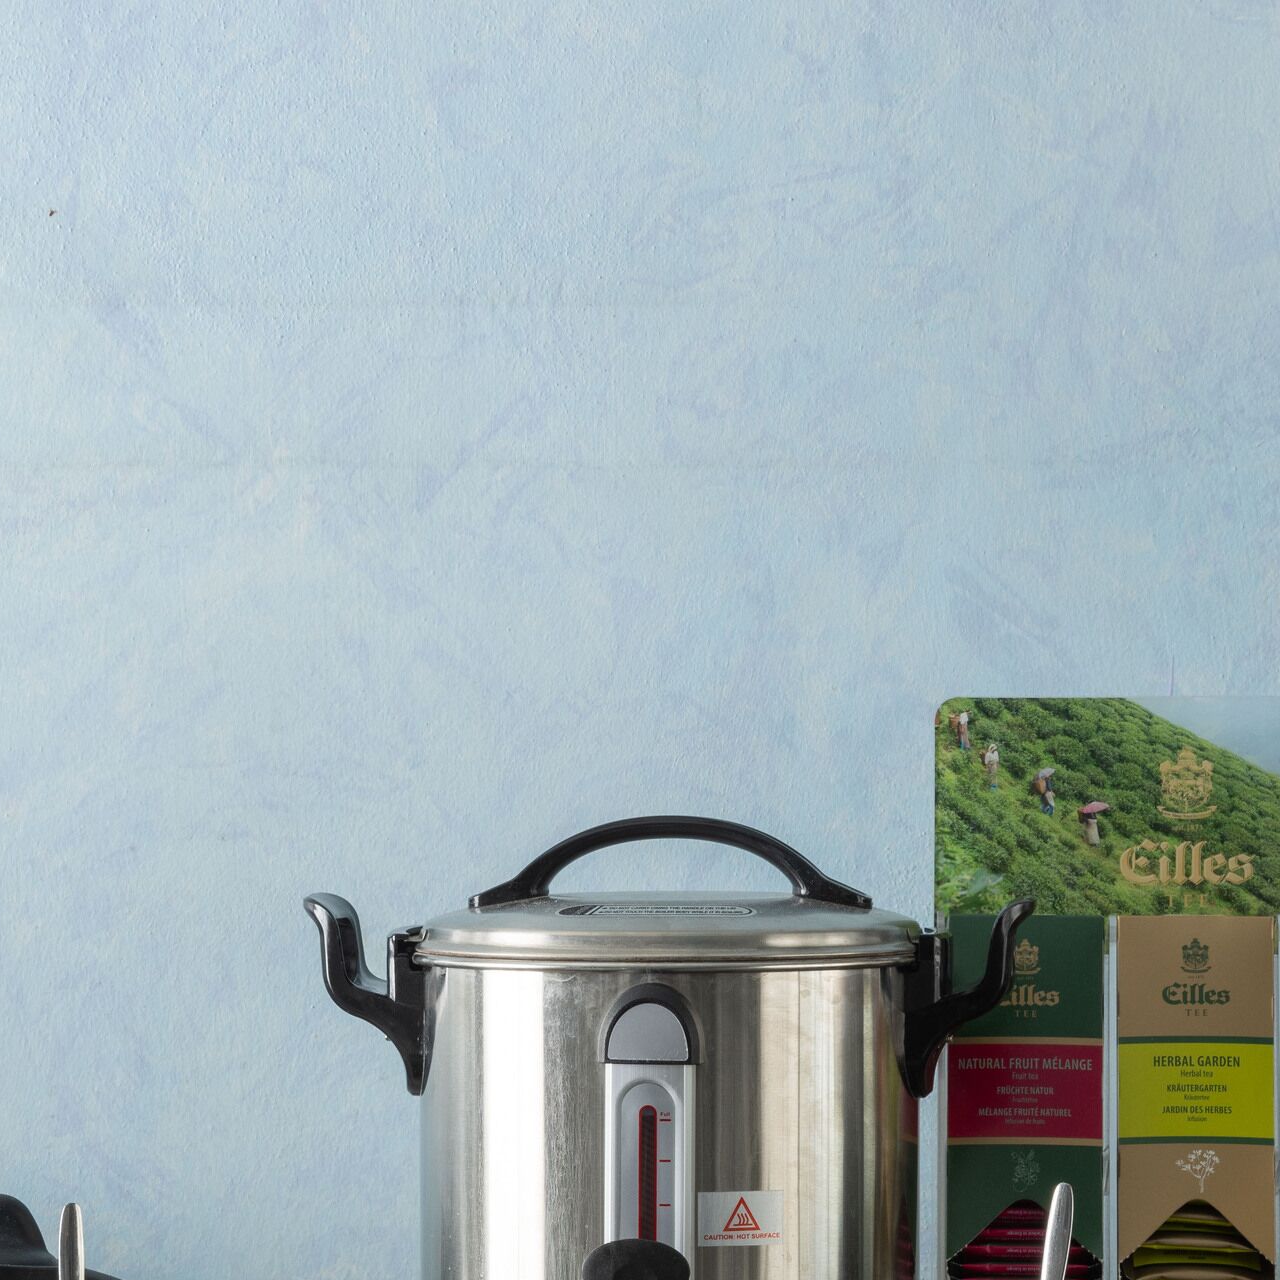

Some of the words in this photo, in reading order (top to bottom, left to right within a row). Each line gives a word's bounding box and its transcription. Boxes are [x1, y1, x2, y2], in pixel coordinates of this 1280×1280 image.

[1120, 838, 1256, 886] Eilles
[1000, 983, 1061, 1007] illes
[1161, 981, 1231, 1006] Eilles
[1015, 1009, 1038, 1018] TEE
[1185, 1008, 1209, 1017] TEE
[958, 1058, 1006, 1070] NATURAL
[1009, 1058, 1040, 1070] FRUIT
[1042, 1056, 1093, 1071] MÉLANGE
[1153, 1055, 1195, 1068] HERBAL
[1197, 1055, 1241, 1068] GARDEN
[1180, 1069, 1202, 1078] Herbal
[1203, 1070, 1214, 1078] tea
[1166, 1082, 1228, 1093] KRÄUTERGARTEN
[1040, 1108, 1072, 1118] NATUREL
[1162, 1105, 1189, 1115] JARDIN
[1189, 1105, 1204, 1115] DES
[1204, 1105, 1233, 1115] HERBES
[751, 1232, 781, 1240] SURFACE
